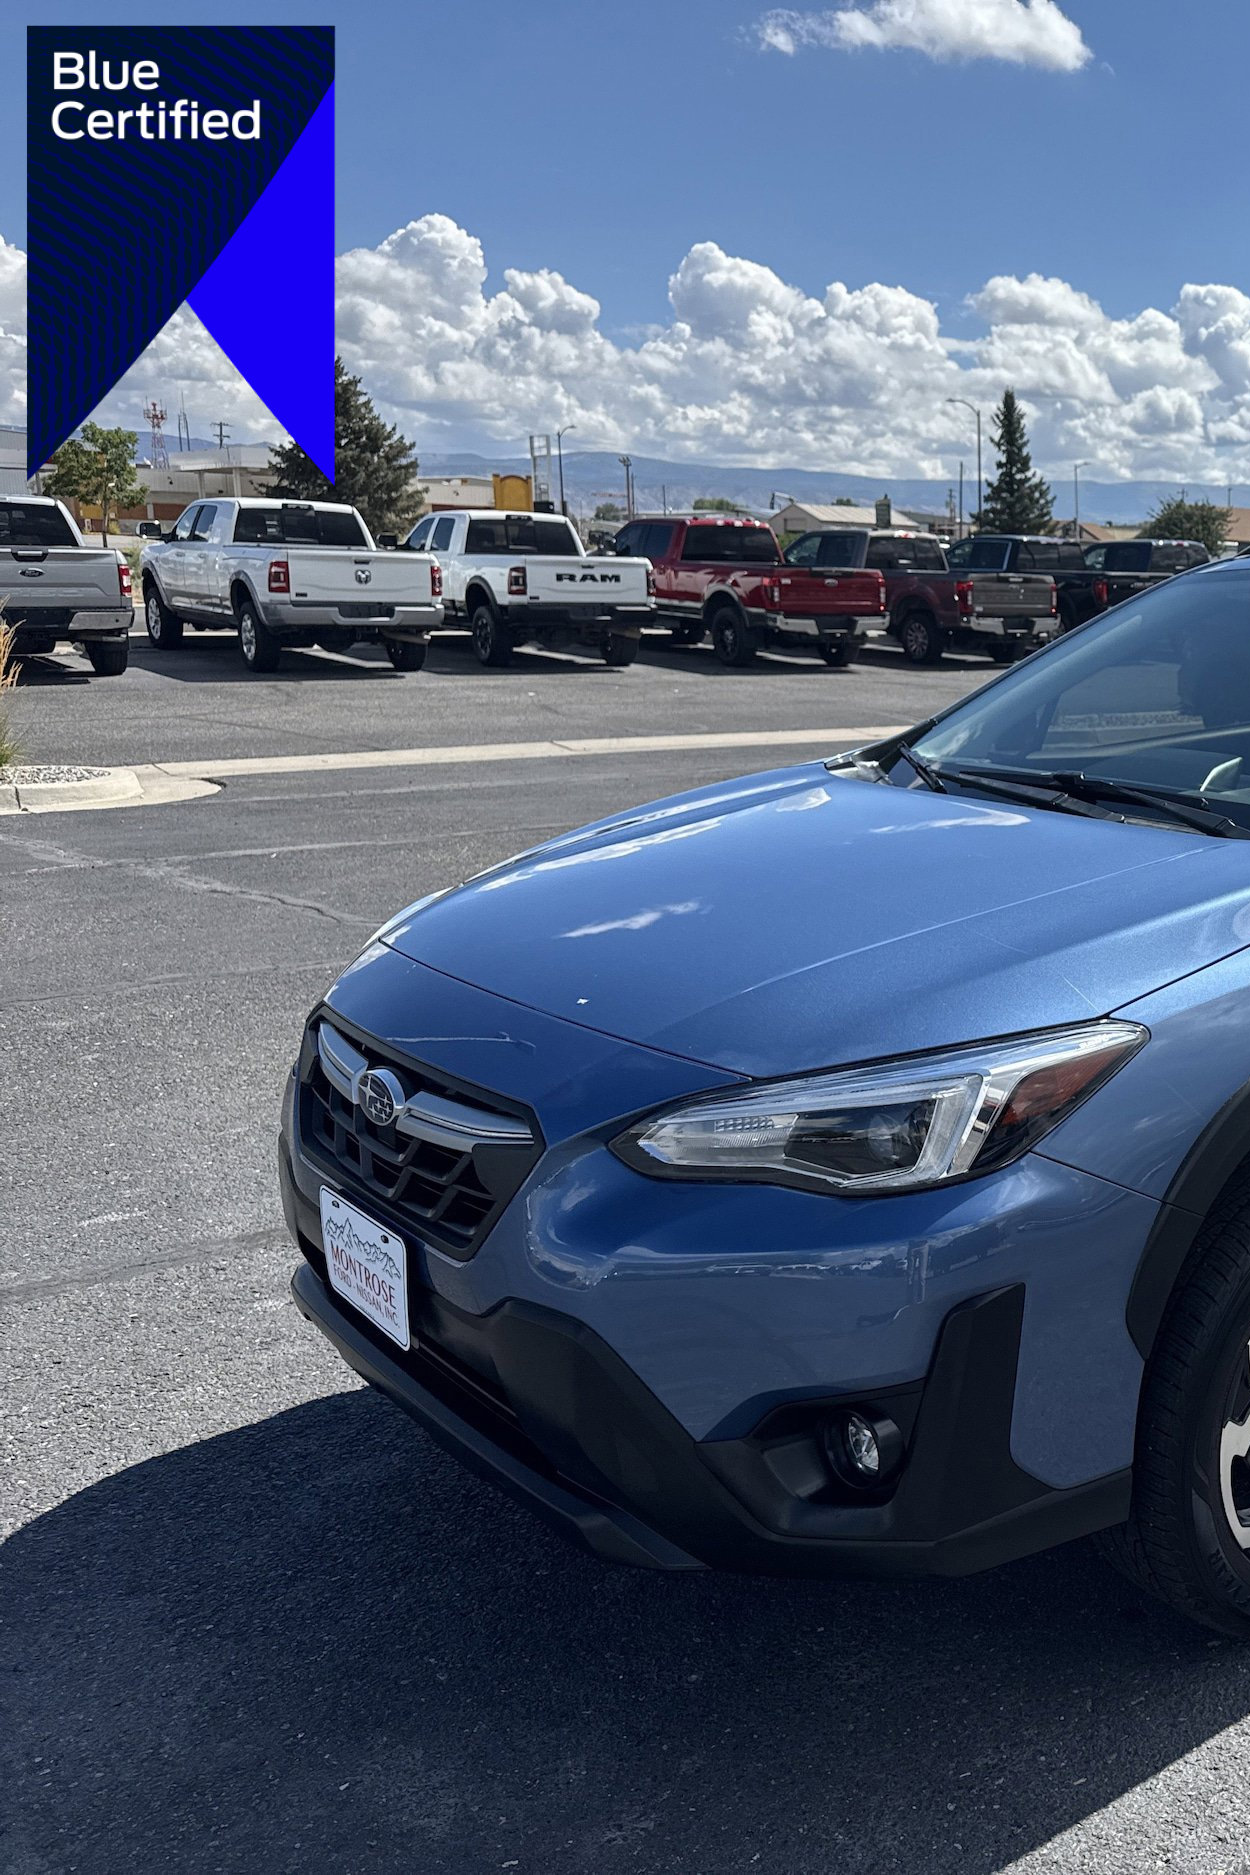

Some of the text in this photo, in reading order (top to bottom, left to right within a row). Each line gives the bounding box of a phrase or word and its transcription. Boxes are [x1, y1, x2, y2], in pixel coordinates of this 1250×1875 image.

[555, 573, 621, 583] RAM
[330, 1240, 397, 1309] MONTROSE
[333, 1263, 352, 1288] FORD
